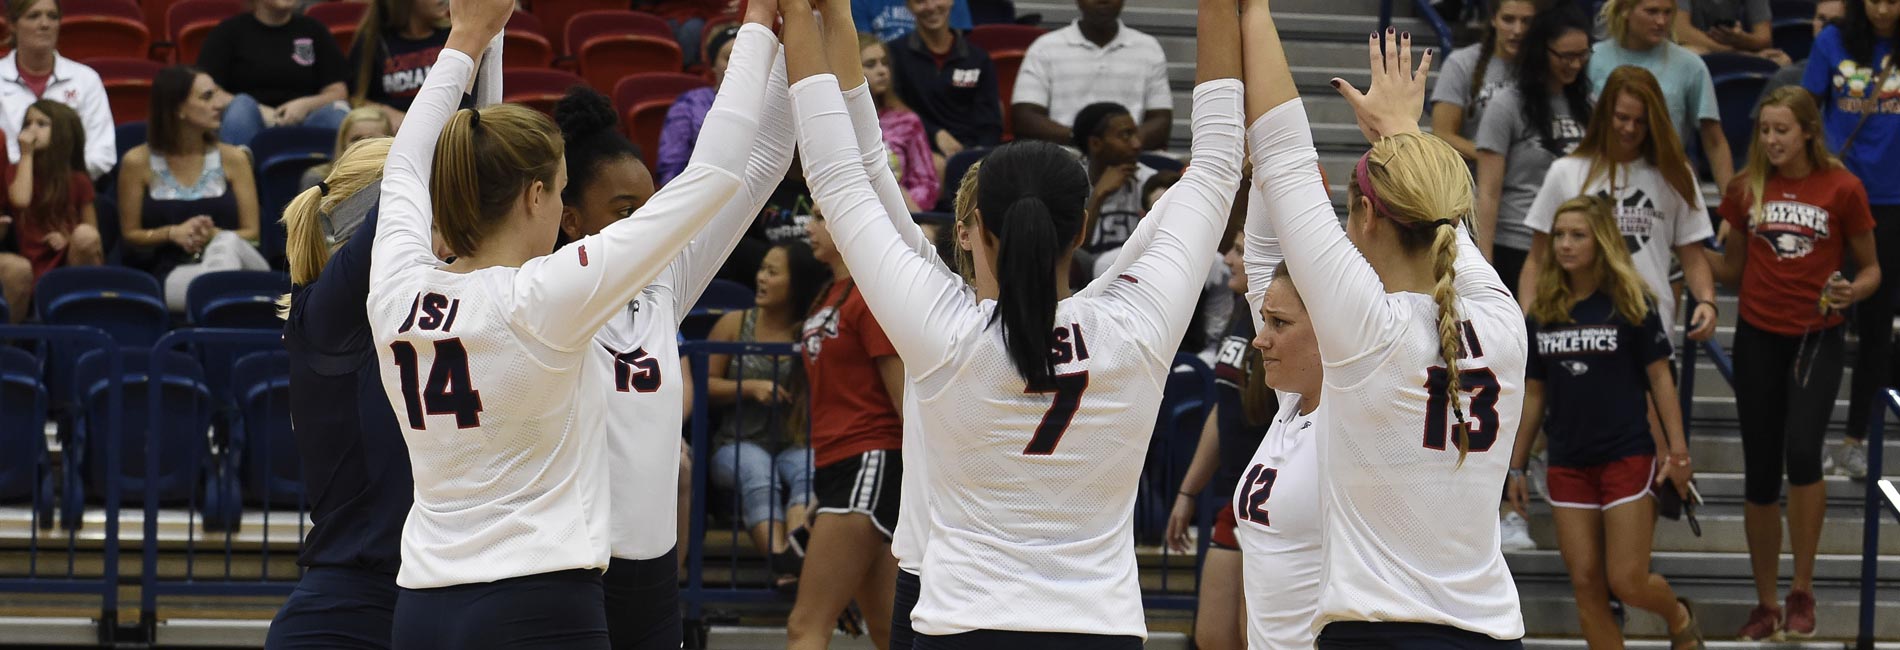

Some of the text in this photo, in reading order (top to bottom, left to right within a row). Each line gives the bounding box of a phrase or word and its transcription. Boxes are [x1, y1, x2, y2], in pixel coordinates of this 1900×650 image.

[614, 346, 662, 393] 15
[1052, 323, 1090, 366] SI
[390, 337, 483, 430] 14
[1023, 370, 1090, 456] 7
[1422, 365, 1502, 452] 13
[1238, 463, 1278, 527] 12
